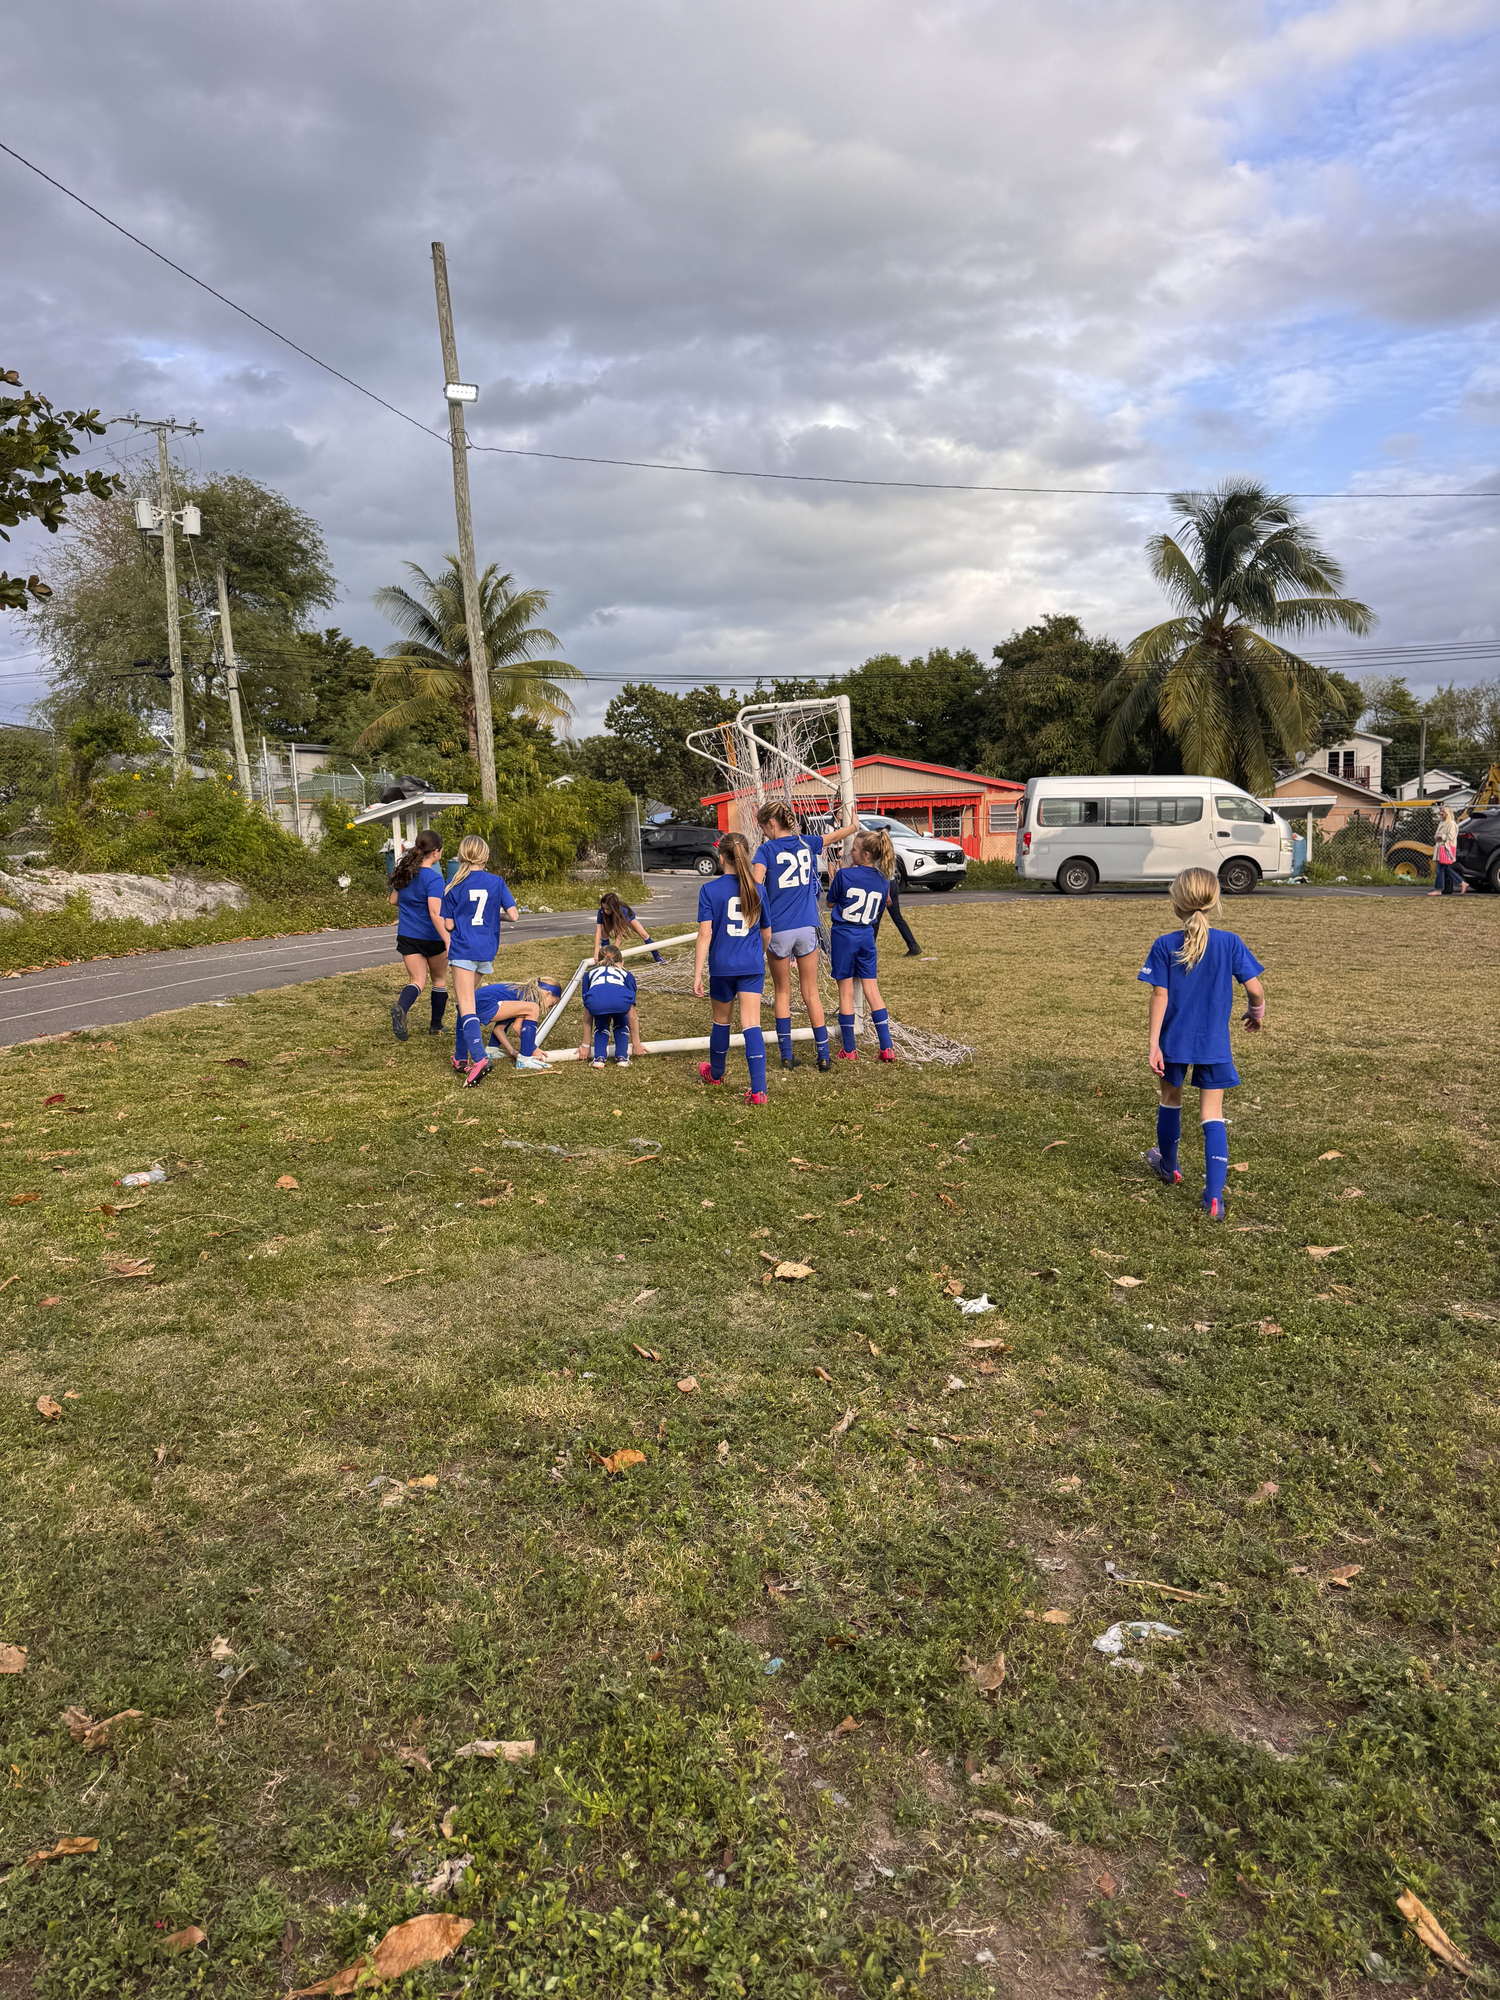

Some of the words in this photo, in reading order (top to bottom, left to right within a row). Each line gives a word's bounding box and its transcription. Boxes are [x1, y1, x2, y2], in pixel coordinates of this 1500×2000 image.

[776, 848, 813, 889] 28
[469, 889, 489, 926] 7
[726, 896, 750, 937] 9
[842, 887, 883, 925] 20
[588, 965, 628, 989] 25
